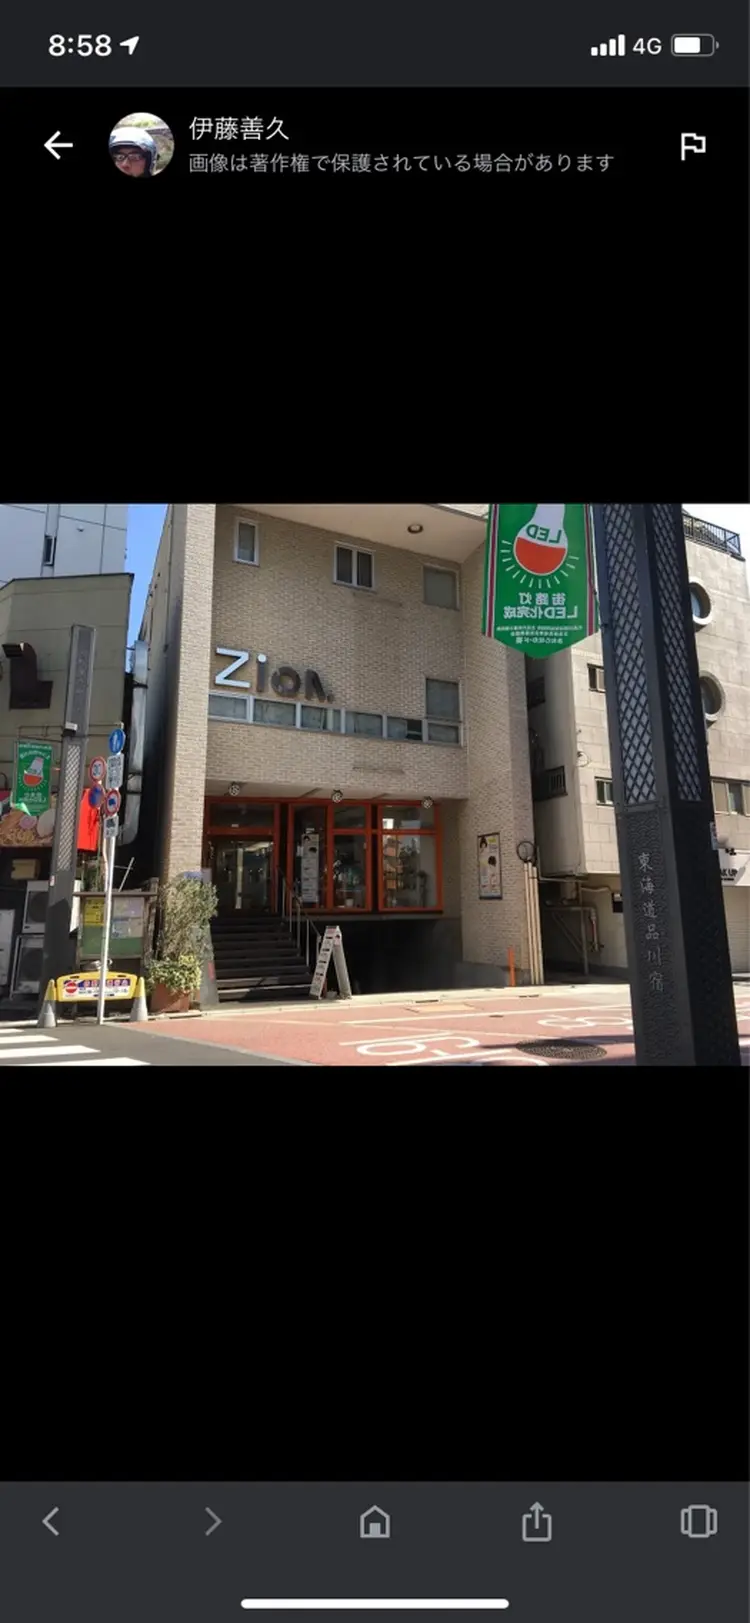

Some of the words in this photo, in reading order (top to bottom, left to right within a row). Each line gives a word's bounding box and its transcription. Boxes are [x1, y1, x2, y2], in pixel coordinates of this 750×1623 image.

[638, 852, 664, 991] 東海道品川宿
